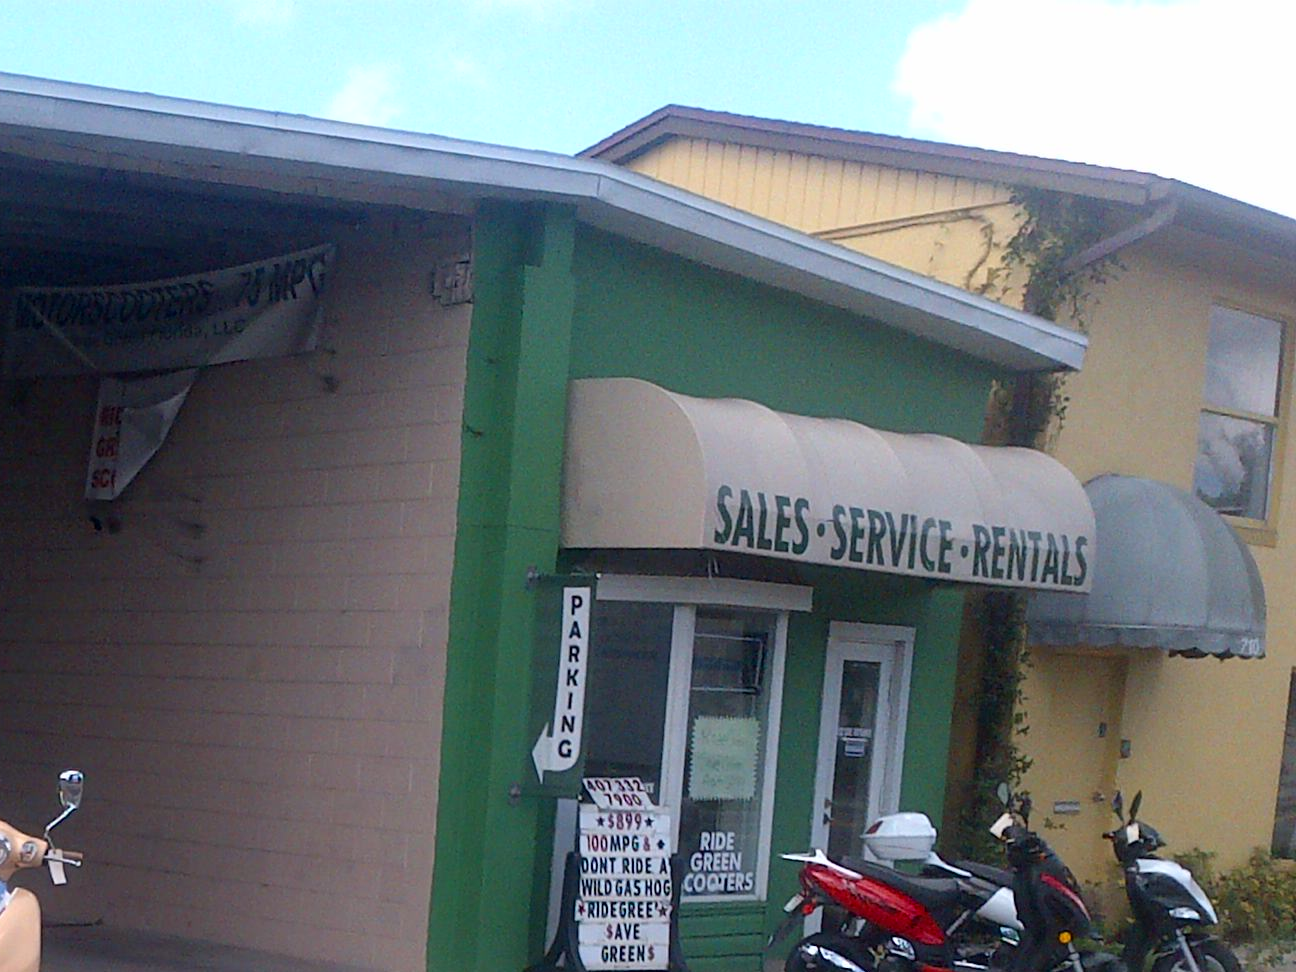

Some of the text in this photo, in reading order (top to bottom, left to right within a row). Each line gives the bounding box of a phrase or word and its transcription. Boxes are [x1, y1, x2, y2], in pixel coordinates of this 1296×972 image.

[714, 485, 1088, 587] SALES SERVICE RENTALS
[557, 594, 583, 759] PARKING
[586, 779, 646, 792] 407 332
[604, 794, 643, 806] 7900
[607, 812, 642, 830] $899
[700, 831, 736, 851] RIDE
[581, 857, 668, 875] DONT RIDE A
[690, 852, 743, 872] GREEN
[581, 879, 671, 897] WILD GAS HOG
[606, 923, 640, 940] $AVE
